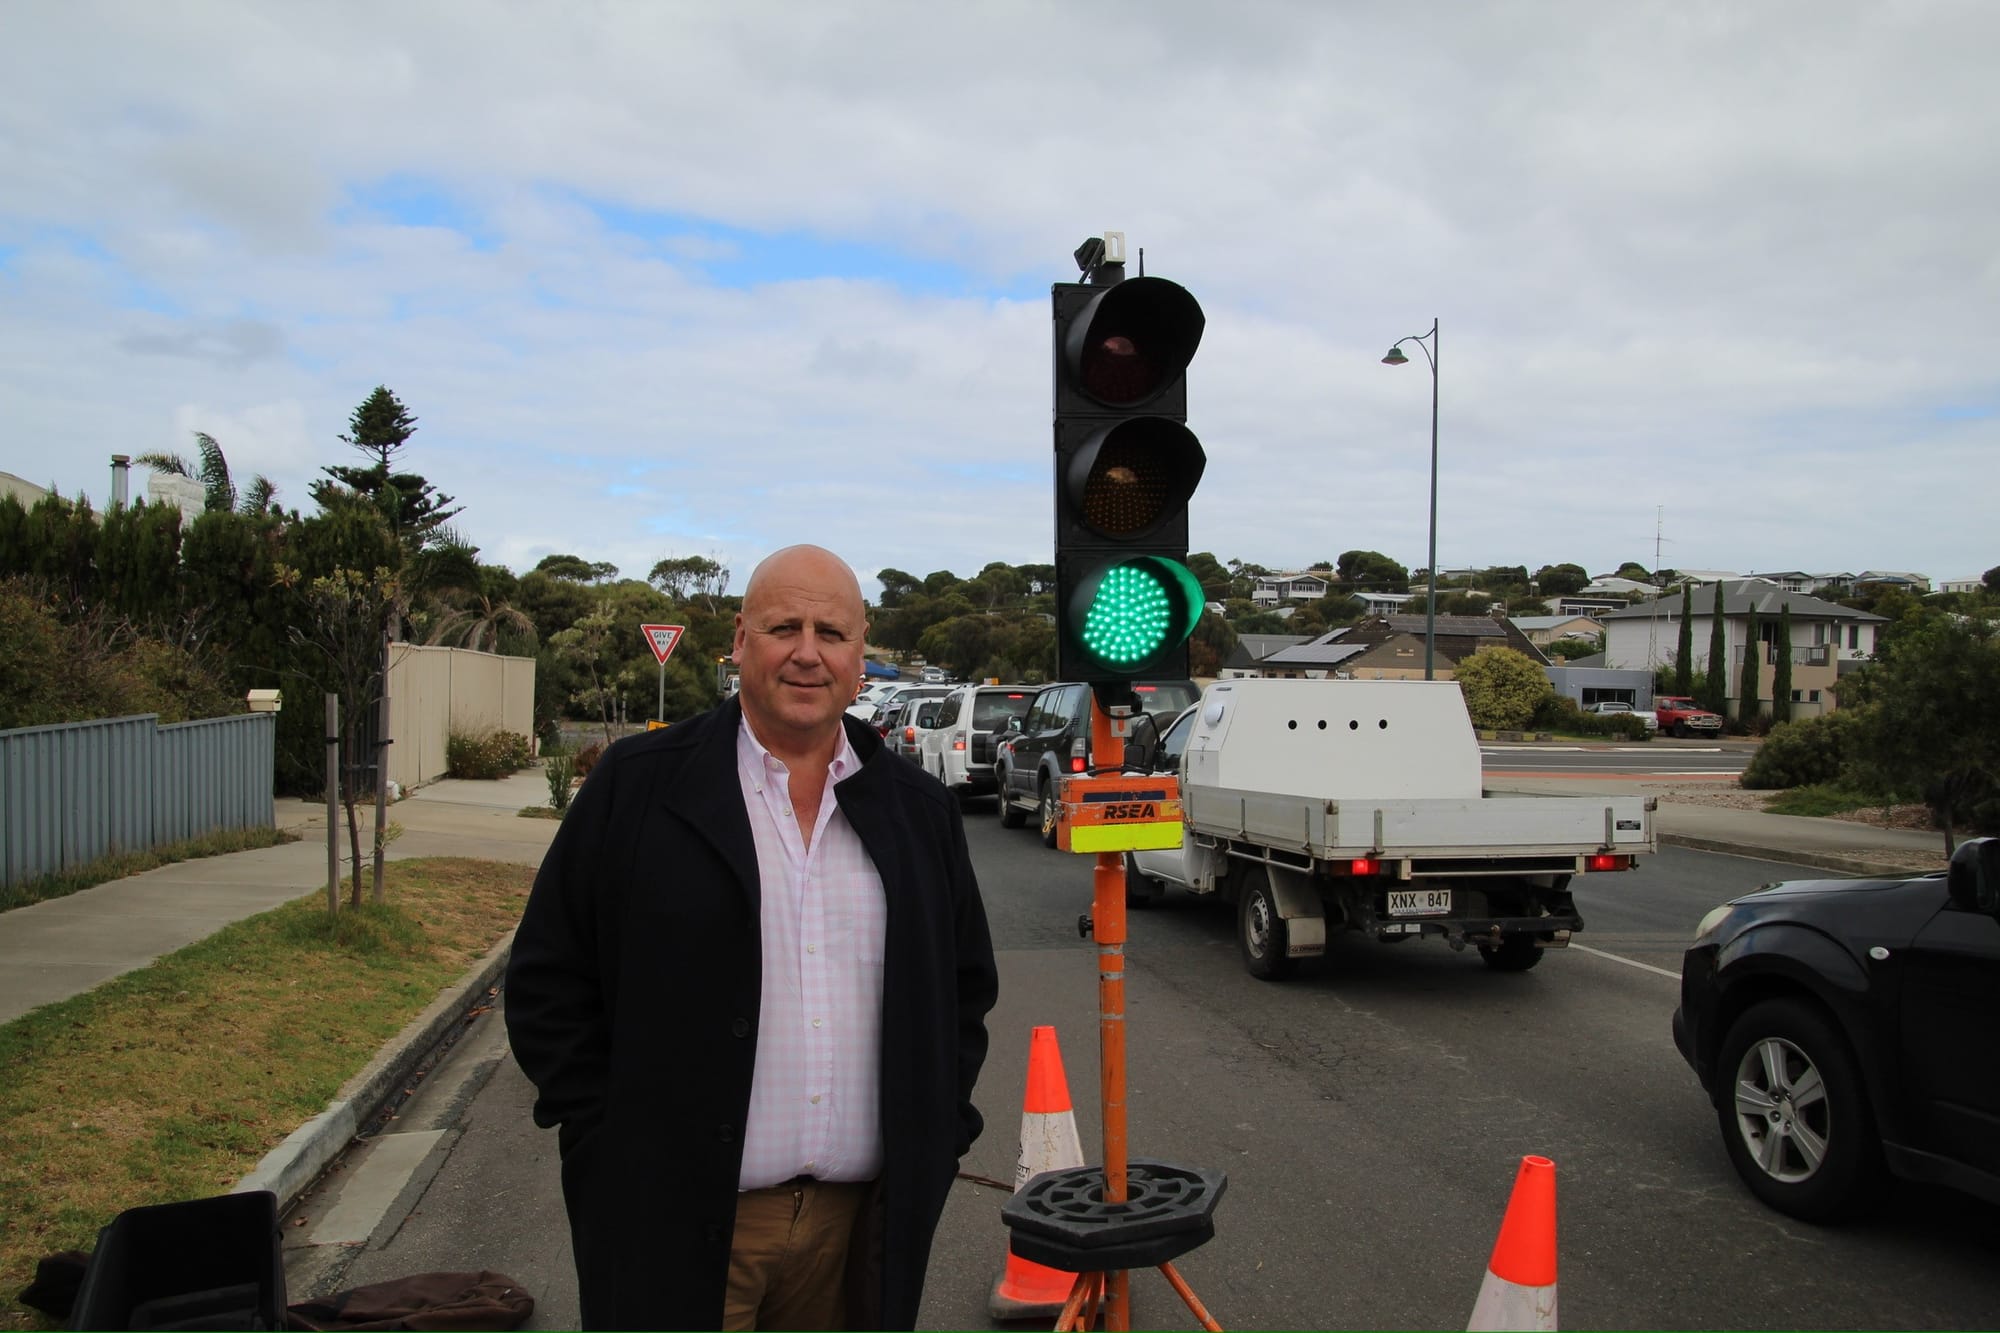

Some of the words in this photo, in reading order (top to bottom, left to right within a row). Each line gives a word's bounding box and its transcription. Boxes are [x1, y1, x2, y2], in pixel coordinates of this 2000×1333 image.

[1104, 804, 1155, 819] RSEA
[1391, 893, 1417, 909] XNX
[1427, 892, 1450, 907] 847
